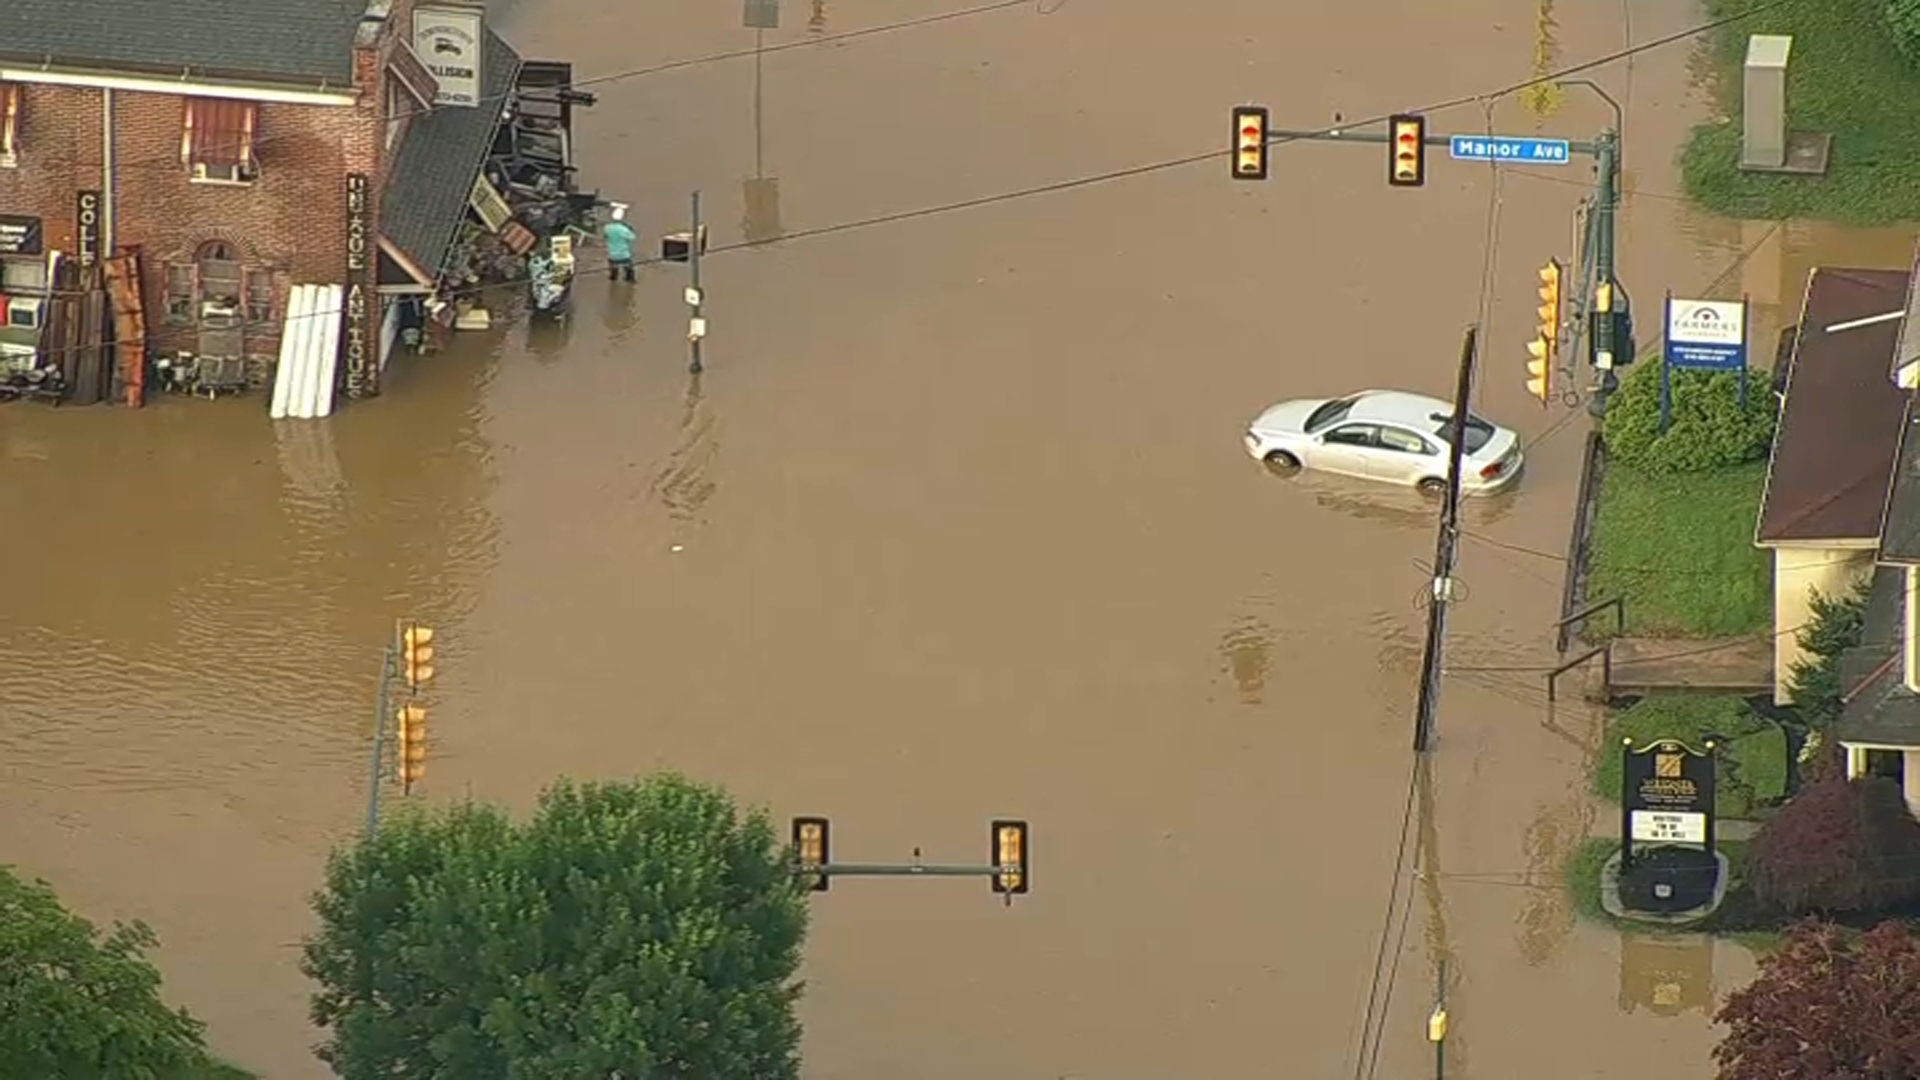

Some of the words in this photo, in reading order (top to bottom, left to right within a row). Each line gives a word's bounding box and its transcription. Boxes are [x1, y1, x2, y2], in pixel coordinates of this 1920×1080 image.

[1459, 140, 1521, 156] Manor
[1533, 143, 1564, 159] Ave
[348, 177, 365, 270] UNIQUE
[1674, 319, 1738, 332] FARMERS
